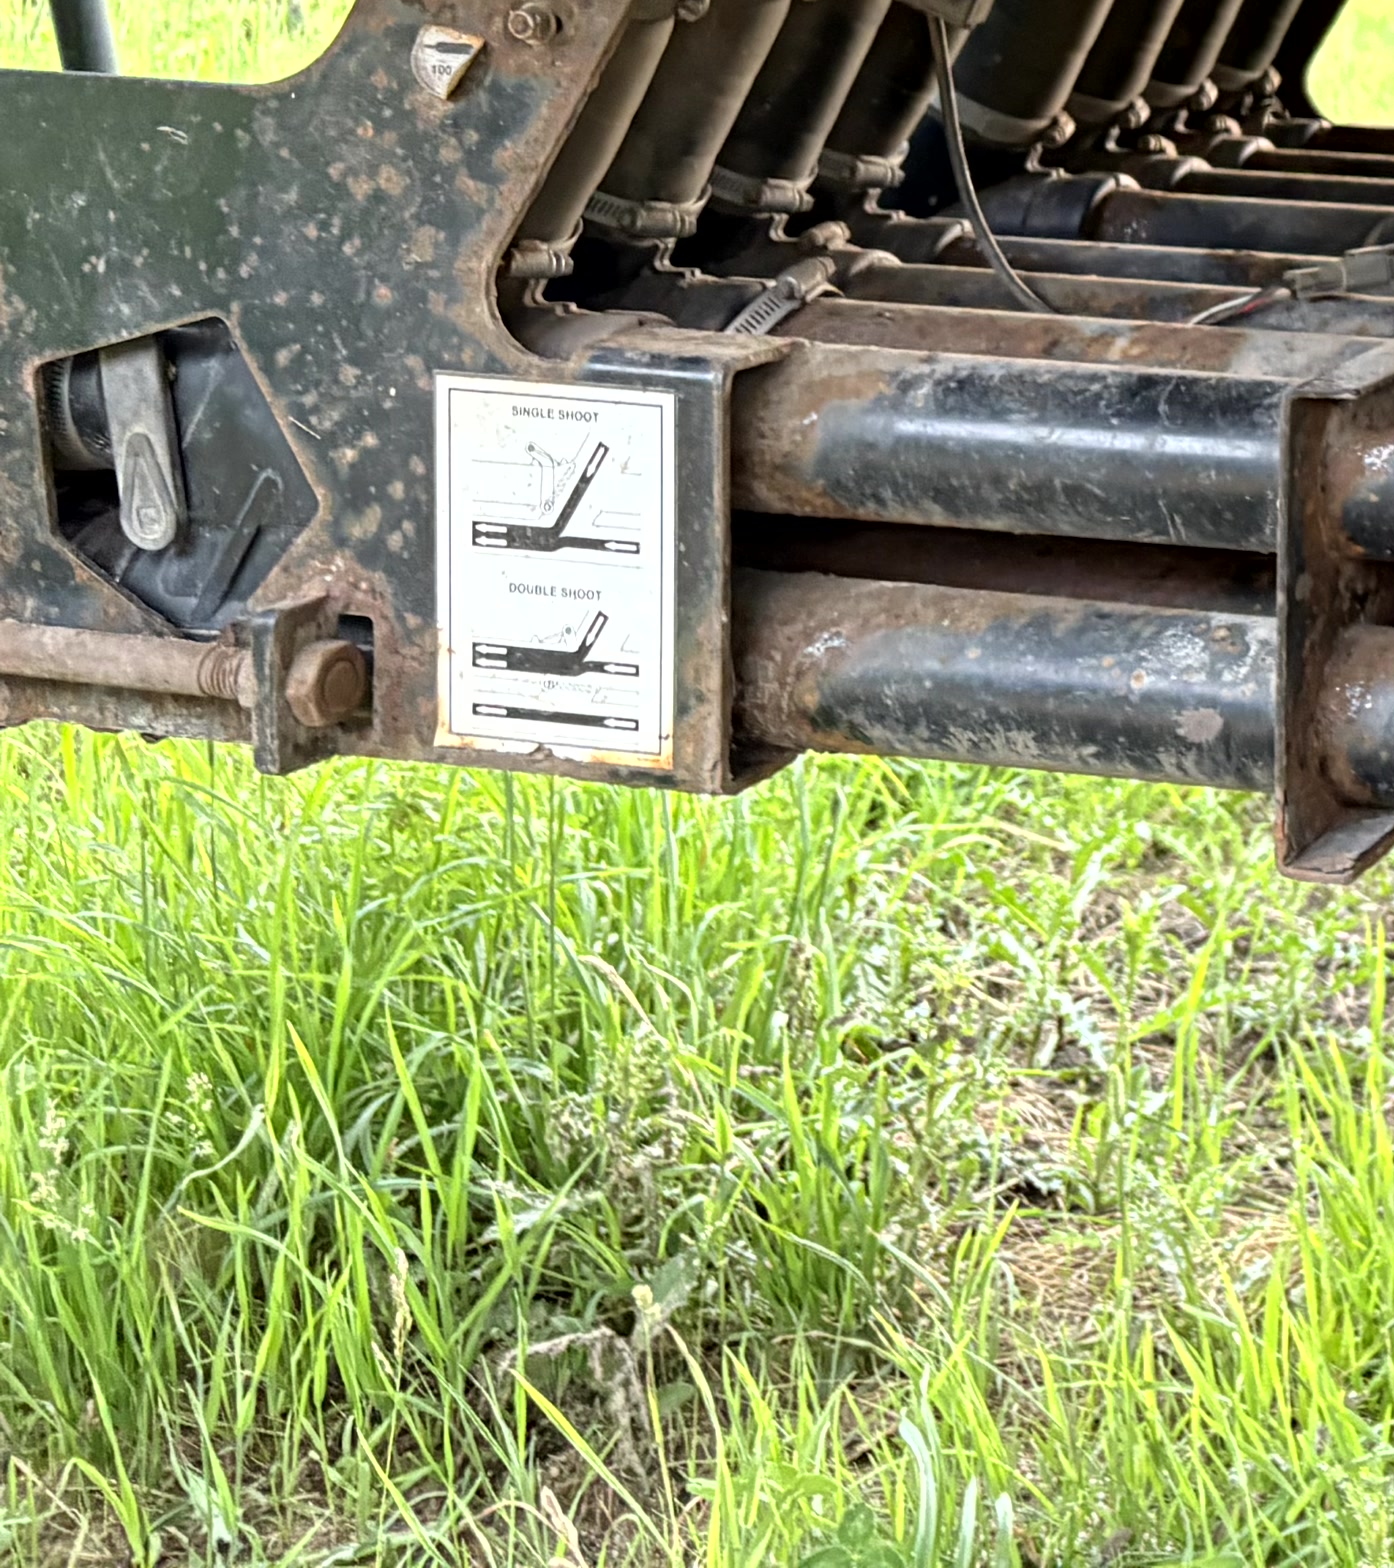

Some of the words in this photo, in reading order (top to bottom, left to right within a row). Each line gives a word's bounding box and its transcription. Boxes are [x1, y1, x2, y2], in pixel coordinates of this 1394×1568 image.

[431, 64, 452, 75] 100
[512, 405, 554, 420] SINGLE
[558, 409, 599, 423] SHOOT
[508, 581, 557, 598] DOUBLE
[561, 586, 602, 601] SHOOT
